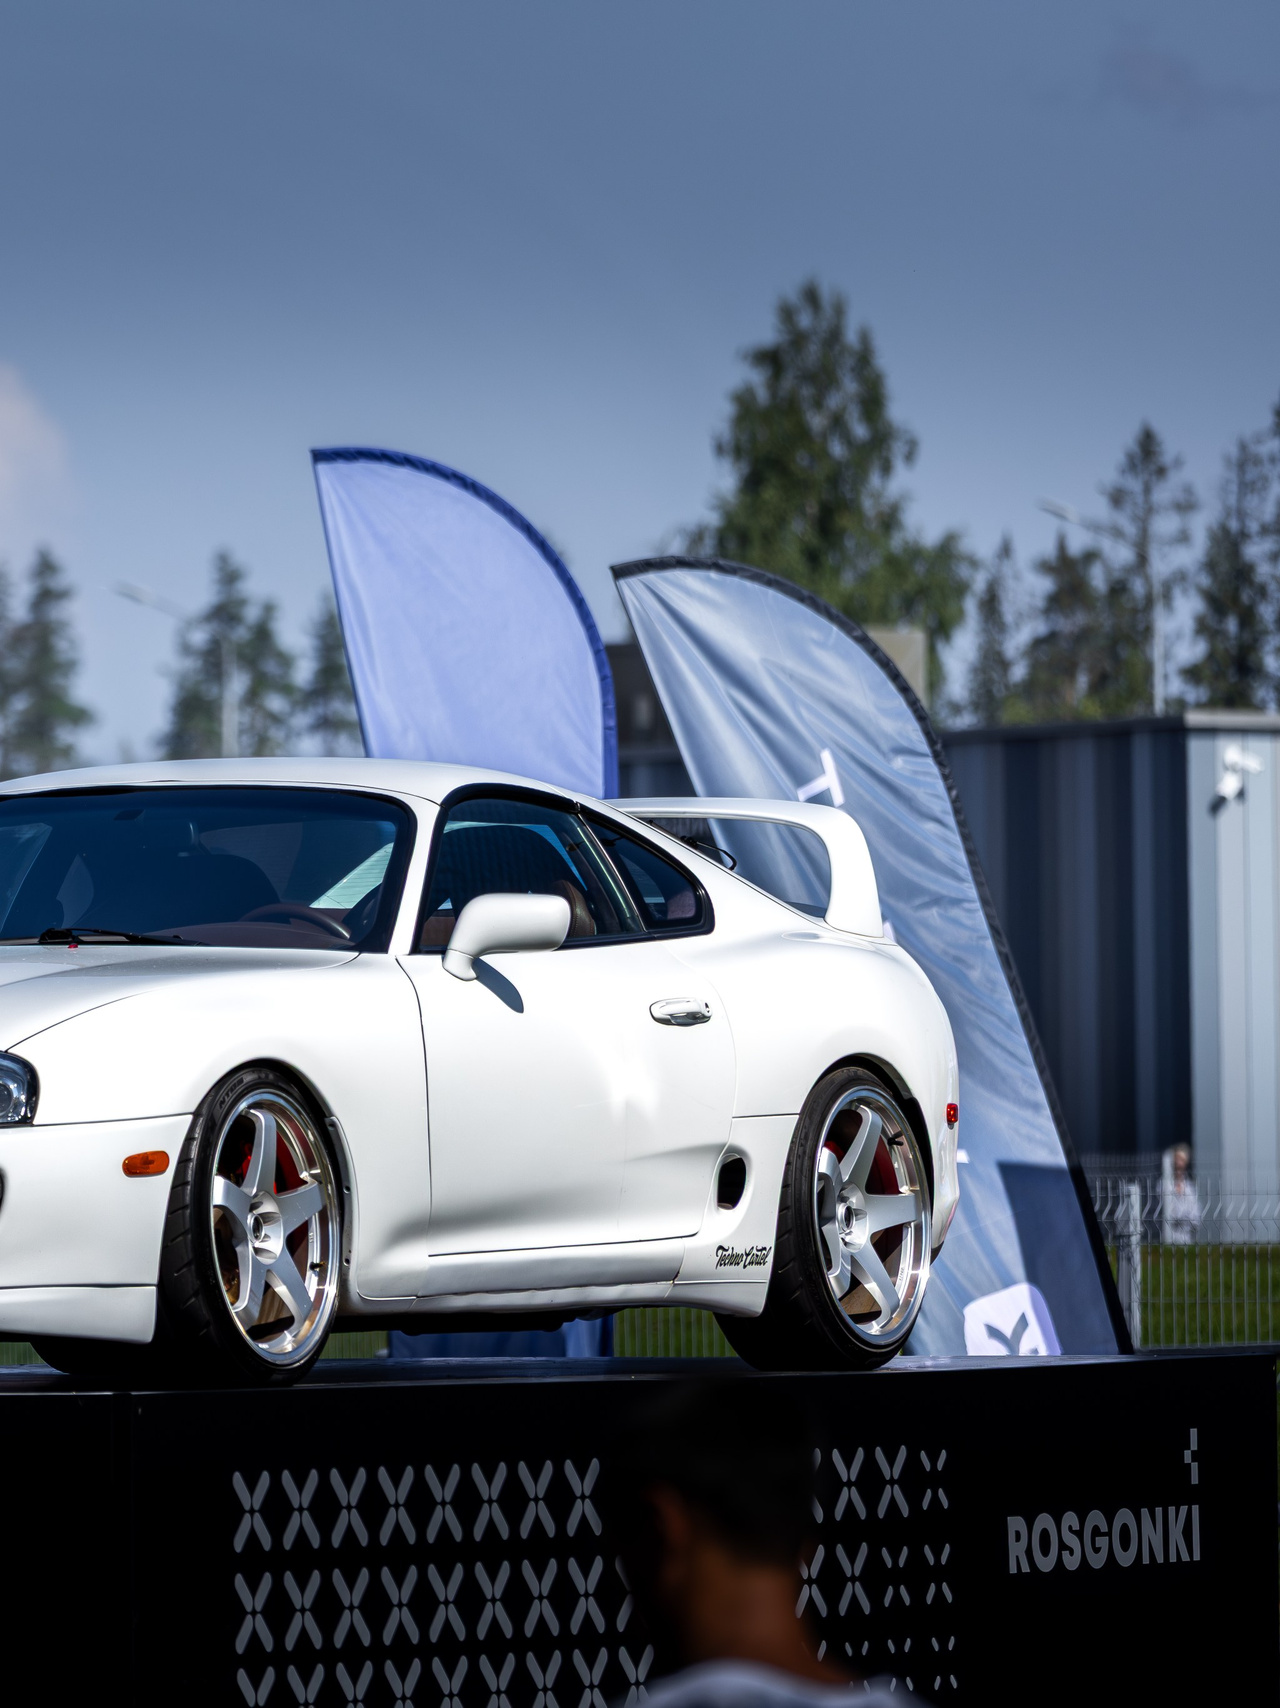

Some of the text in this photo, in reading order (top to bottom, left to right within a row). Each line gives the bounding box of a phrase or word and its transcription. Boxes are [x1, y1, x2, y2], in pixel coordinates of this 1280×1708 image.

[715, 1244, 772, 1270] Techno Cartel
[1007, 1504, 1201, 1574] ROSGONKI
